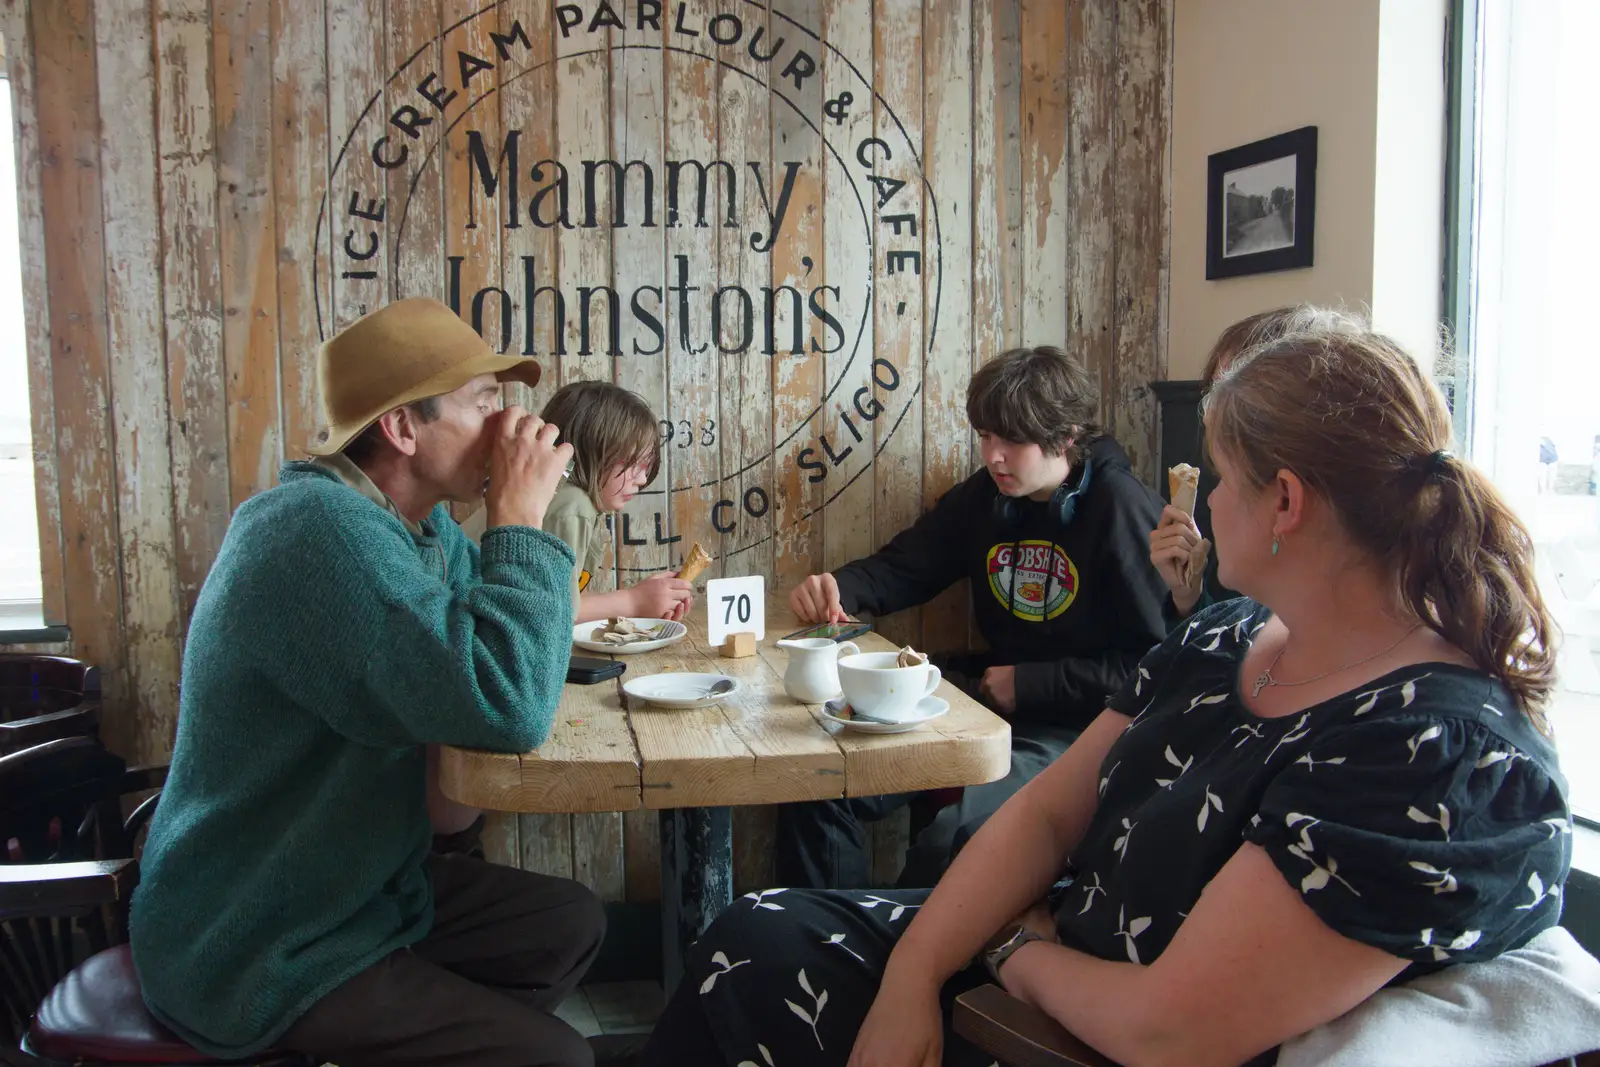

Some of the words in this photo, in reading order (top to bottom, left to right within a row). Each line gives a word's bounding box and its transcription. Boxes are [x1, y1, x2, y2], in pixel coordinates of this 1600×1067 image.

[341, 190, 386, 280] ICE
[371, 20, 534, 170] CREAM
[555, 0, 817, 91] PARLOUR
[823, 91, 854, 126] &
[856, 136, 922, 277] CAFE
[465, 130, 803, 253] Mammy
[445, 254, 846, 357] Johnston's
[657, 419, 716, 449] 938
[711, 486, 770, 535] CO
[796, 357, 901, 484] SLIGO
[721, 593, 751, 625] 70
[997, 547, 1067, 580] GOBSHTE
